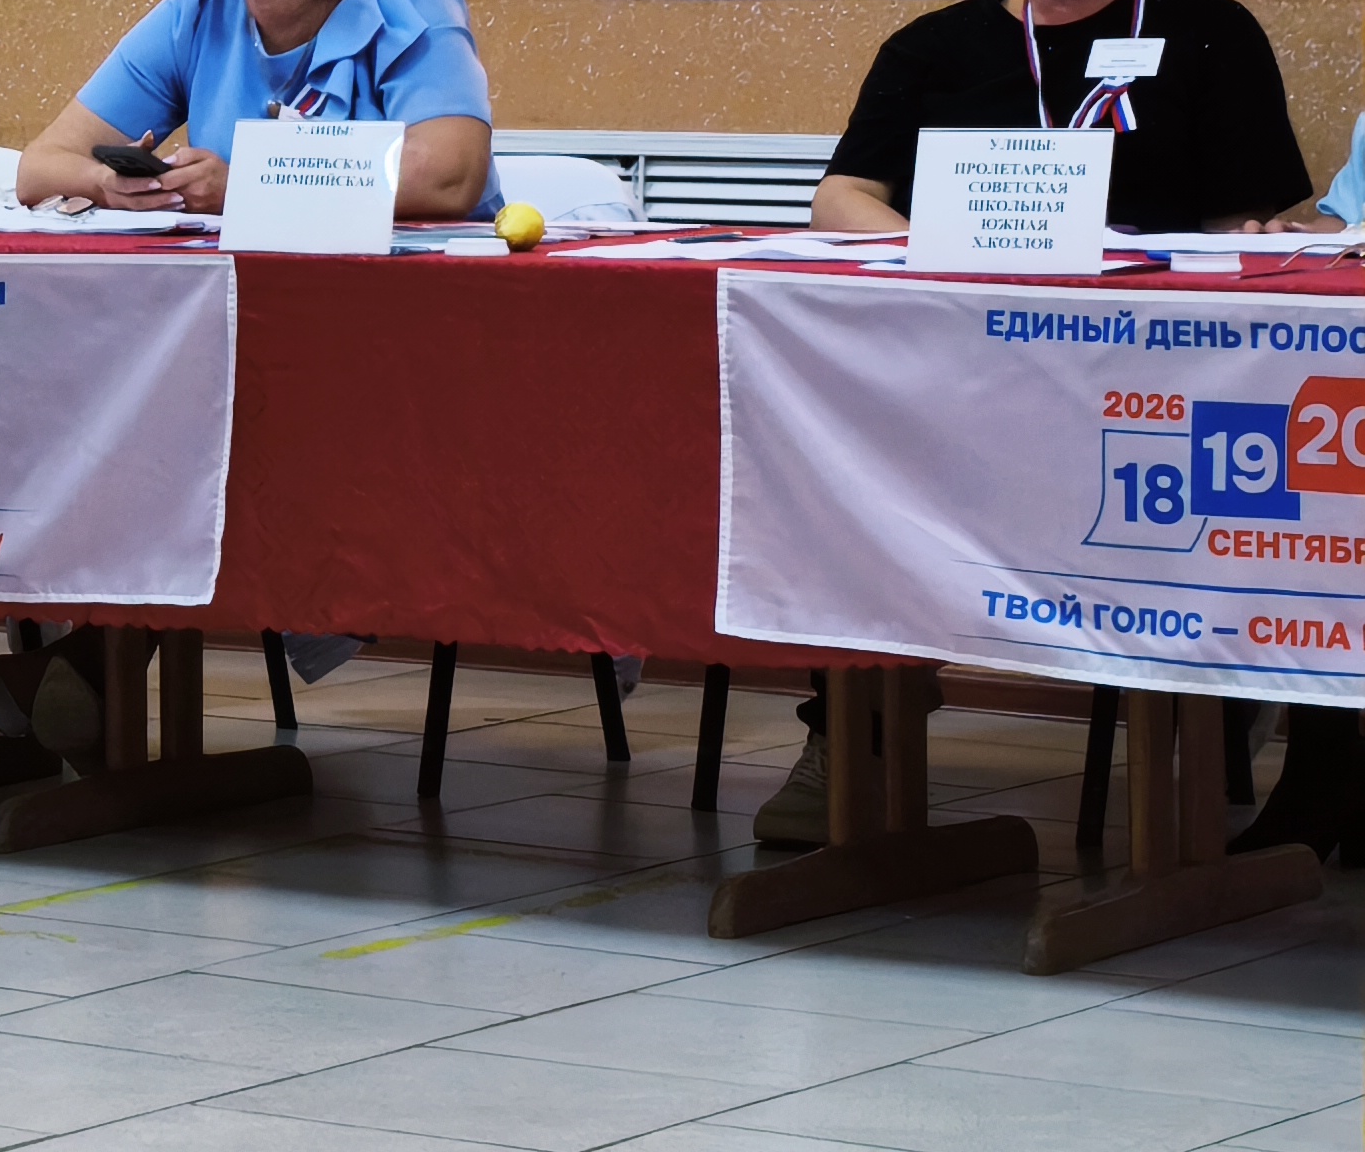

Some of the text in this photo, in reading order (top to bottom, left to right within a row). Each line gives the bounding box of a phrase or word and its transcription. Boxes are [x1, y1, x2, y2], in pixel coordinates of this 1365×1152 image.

[990, 138, 1056, 151] УЛИЦЫ:
[268, 156, 372, 170] ОКТЯБРЬСКАЯ
[954, 162, 1087, 176] ПРОЛЕТАРСКАЯ
[260, 173, 374, 187] ОЛИМПИЙСКАЯ
[968, 181, 1068, 194] СОВЕТСКАЯ
[968, 200, 1065, 213] ШКОЛЬНАЯ
[981, 218, 1048, 231] ЮЖНАЯ
[986, 310, 1365, 354] ЕДИНЫЙ ДЕНЬ ГОЛОС
[1103, 391, 1185, 420] 2026
[1113, 462, 1184, 525] 18
[1202, 432, 1278, 494] 19
[1208, 529, 1365, 564] СЕНТЯБР
[982, 590, 1082, 628] ТВОЙ
[1093, 604, 1202, 639] ГОЛОС
[1248, 616, 1351, 650] СИЛА
